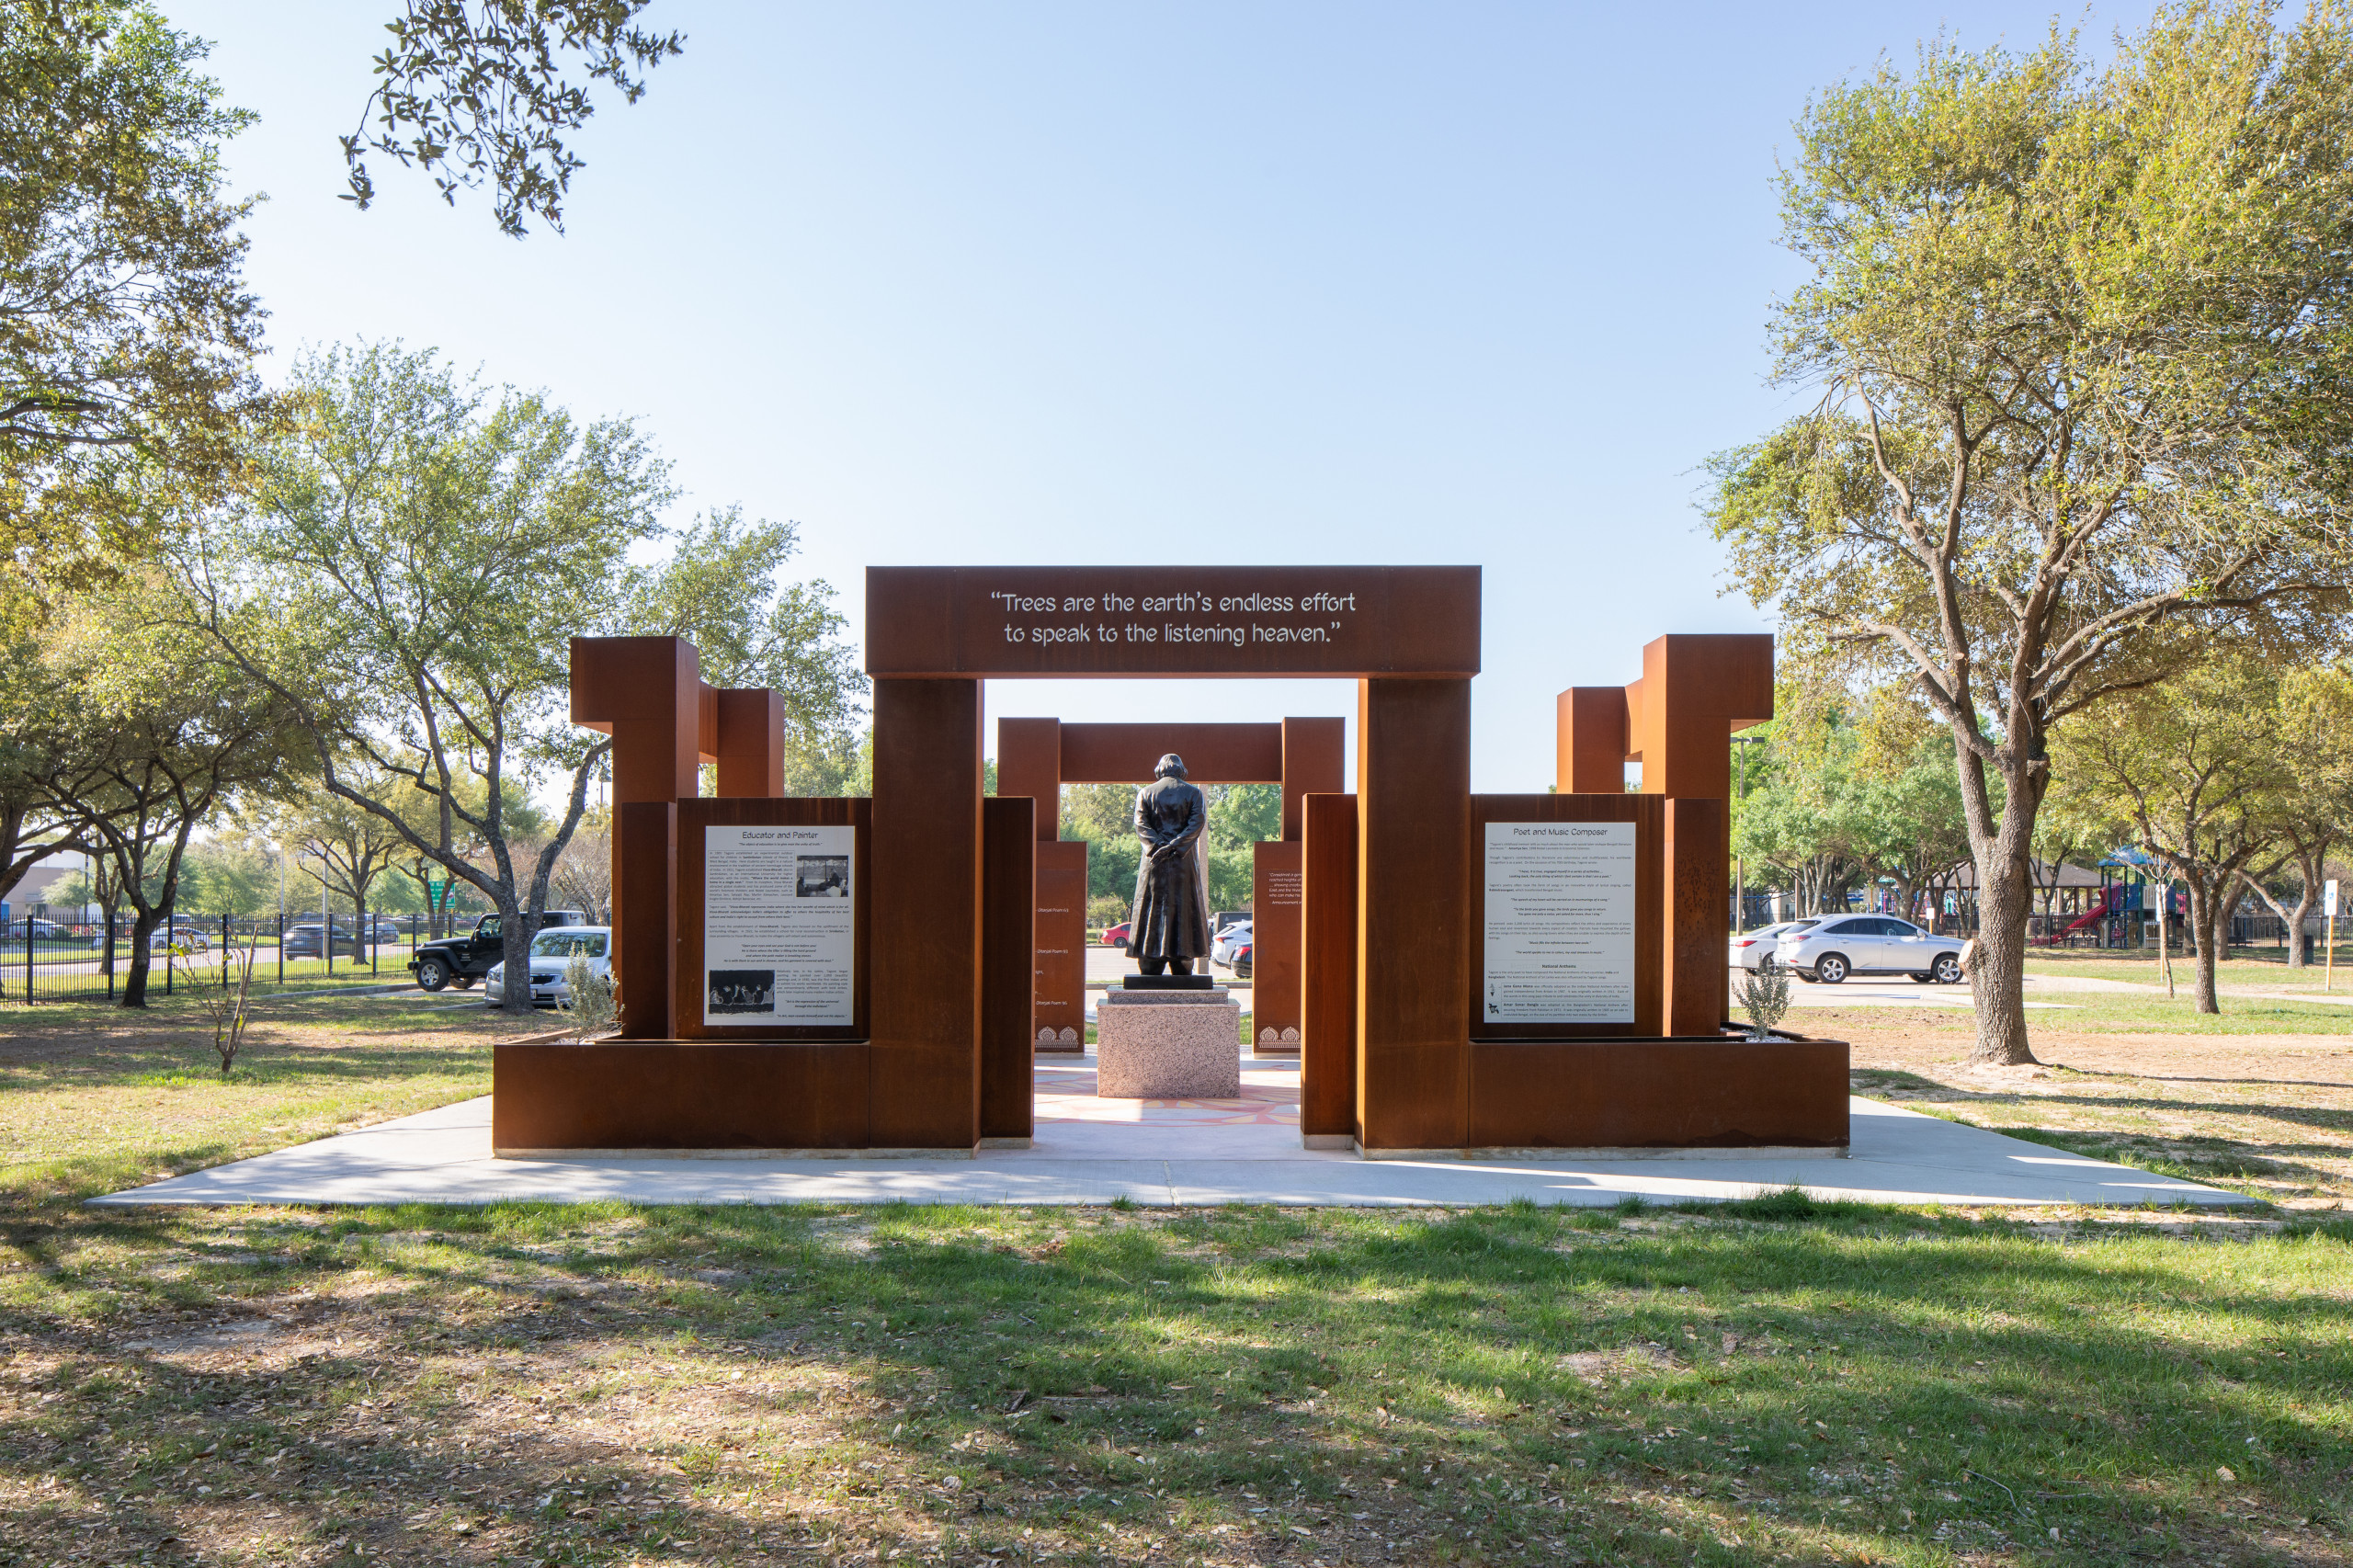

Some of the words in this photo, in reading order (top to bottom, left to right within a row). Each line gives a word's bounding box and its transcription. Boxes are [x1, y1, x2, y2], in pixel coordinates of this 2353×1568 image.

[992, 592, 1056, 611] “Trees
[1063, 597, 1095, 611] are
[1102, 593, 1134, 611] the
[1142, 592, 1211, 611] earth’s
[1220, 593, 1293, 611] endless
[1302, 593, 1356, 611] effort
[1005, 624, 1025, 642] to
[1032, 623, 1089, 646] speak
[1097, 624, 1118, 642] to
[1125, 623, 1157, 642] the
[1165, 623, 1244, 646] listening
[1253, 622, 1340, 642] heaven.”
[1571, 828, 1608, 836] Composer
